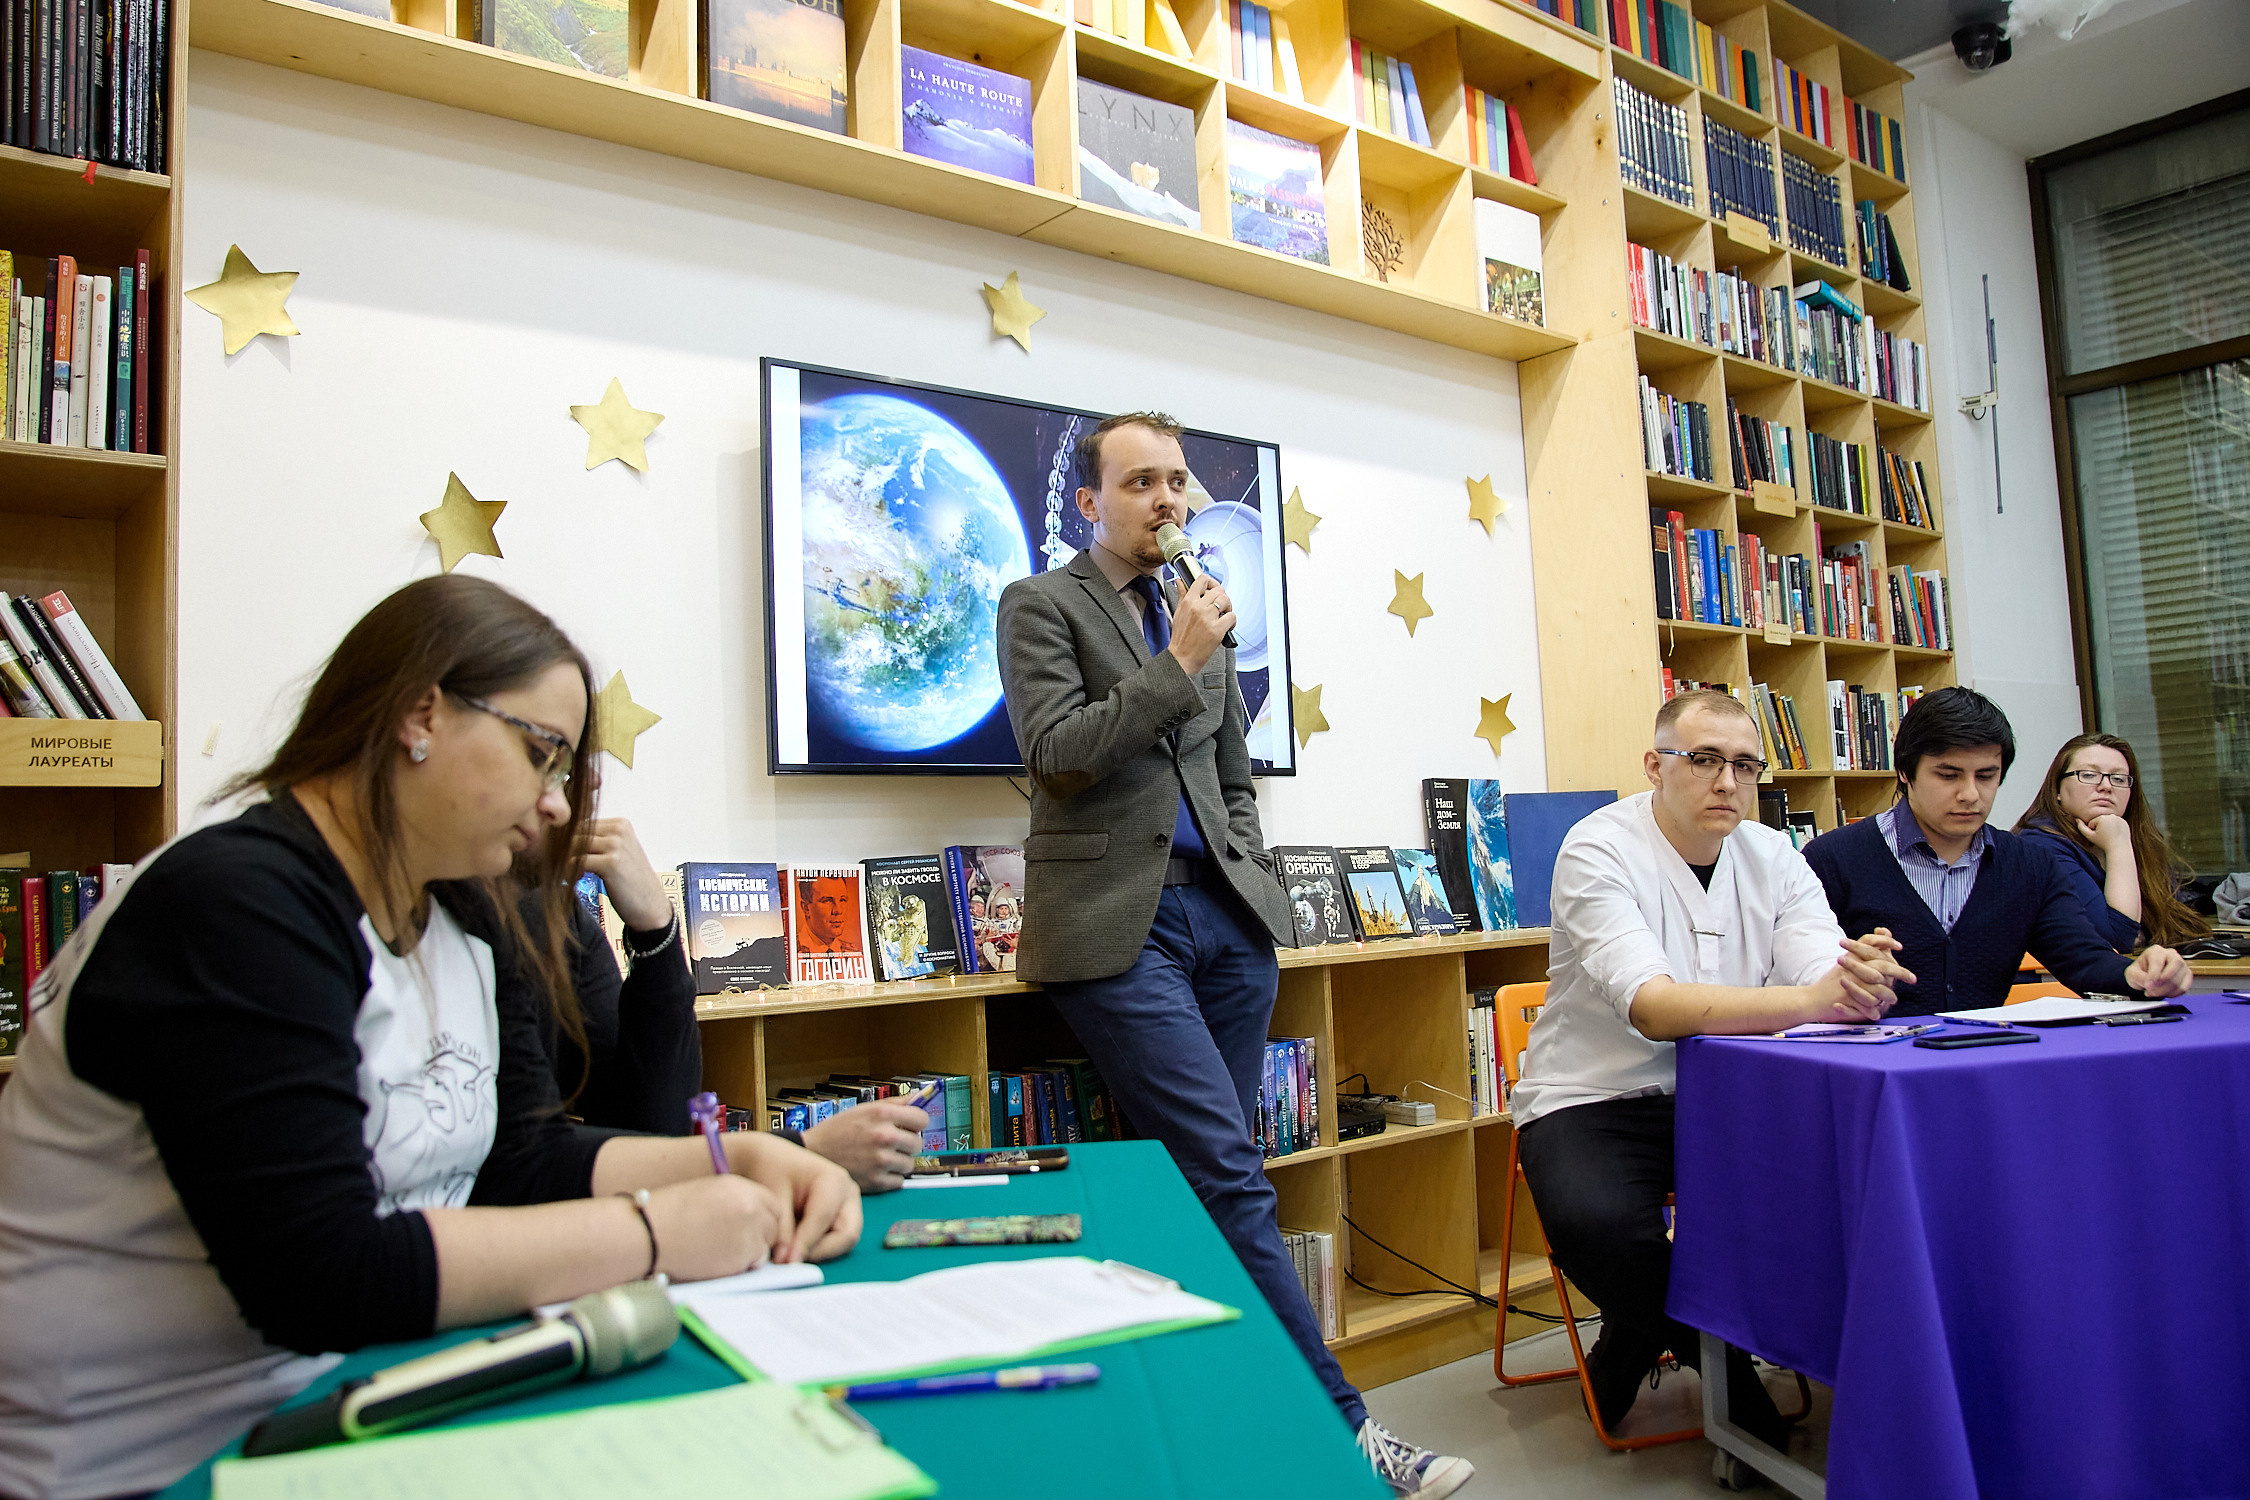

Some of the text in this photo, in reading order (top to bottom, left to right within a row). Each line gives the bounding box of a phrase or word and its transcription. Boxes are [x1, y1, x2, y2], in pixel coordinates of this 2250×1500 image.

[94, 14, 104, 87] ДНЕВНИК АННЫ ФРАНК
[910, 68, 1023, 107] LA HAUTE ROUTE
[1077, 86, 1184, 142] LYNX
[120, 309, 131, 358] 中国地理常识
[31, 737, 112, 749] МИРОВЫЕ
[28, 756, 113, 768] ЛАУРЕАТЫ
[1435, 798, 1454, 808] Наш
[1437, 819, 1461, 830] Земля
[983, 847, 1020, 859] СССР СОЮЗ
[796, 869, 857, 878] АНТОН ПЕРВУШИН
[1285, 862, 1335, 875] ОРБИТЫ
[699, 879, 768, 891] КОСМИЧЕСКИЕ
[882, 873, 941, 886] В КОСМОСЕ
[700, 893, 770, 912] ИСТОРИИ
[955, 896, 965, 933] ОТЕЧЕСТВЕННОЙ
[961, 934, 971, 971] КОСМОНАВТИКИ
[797, 957, 867, 981] ГАГАРИН
